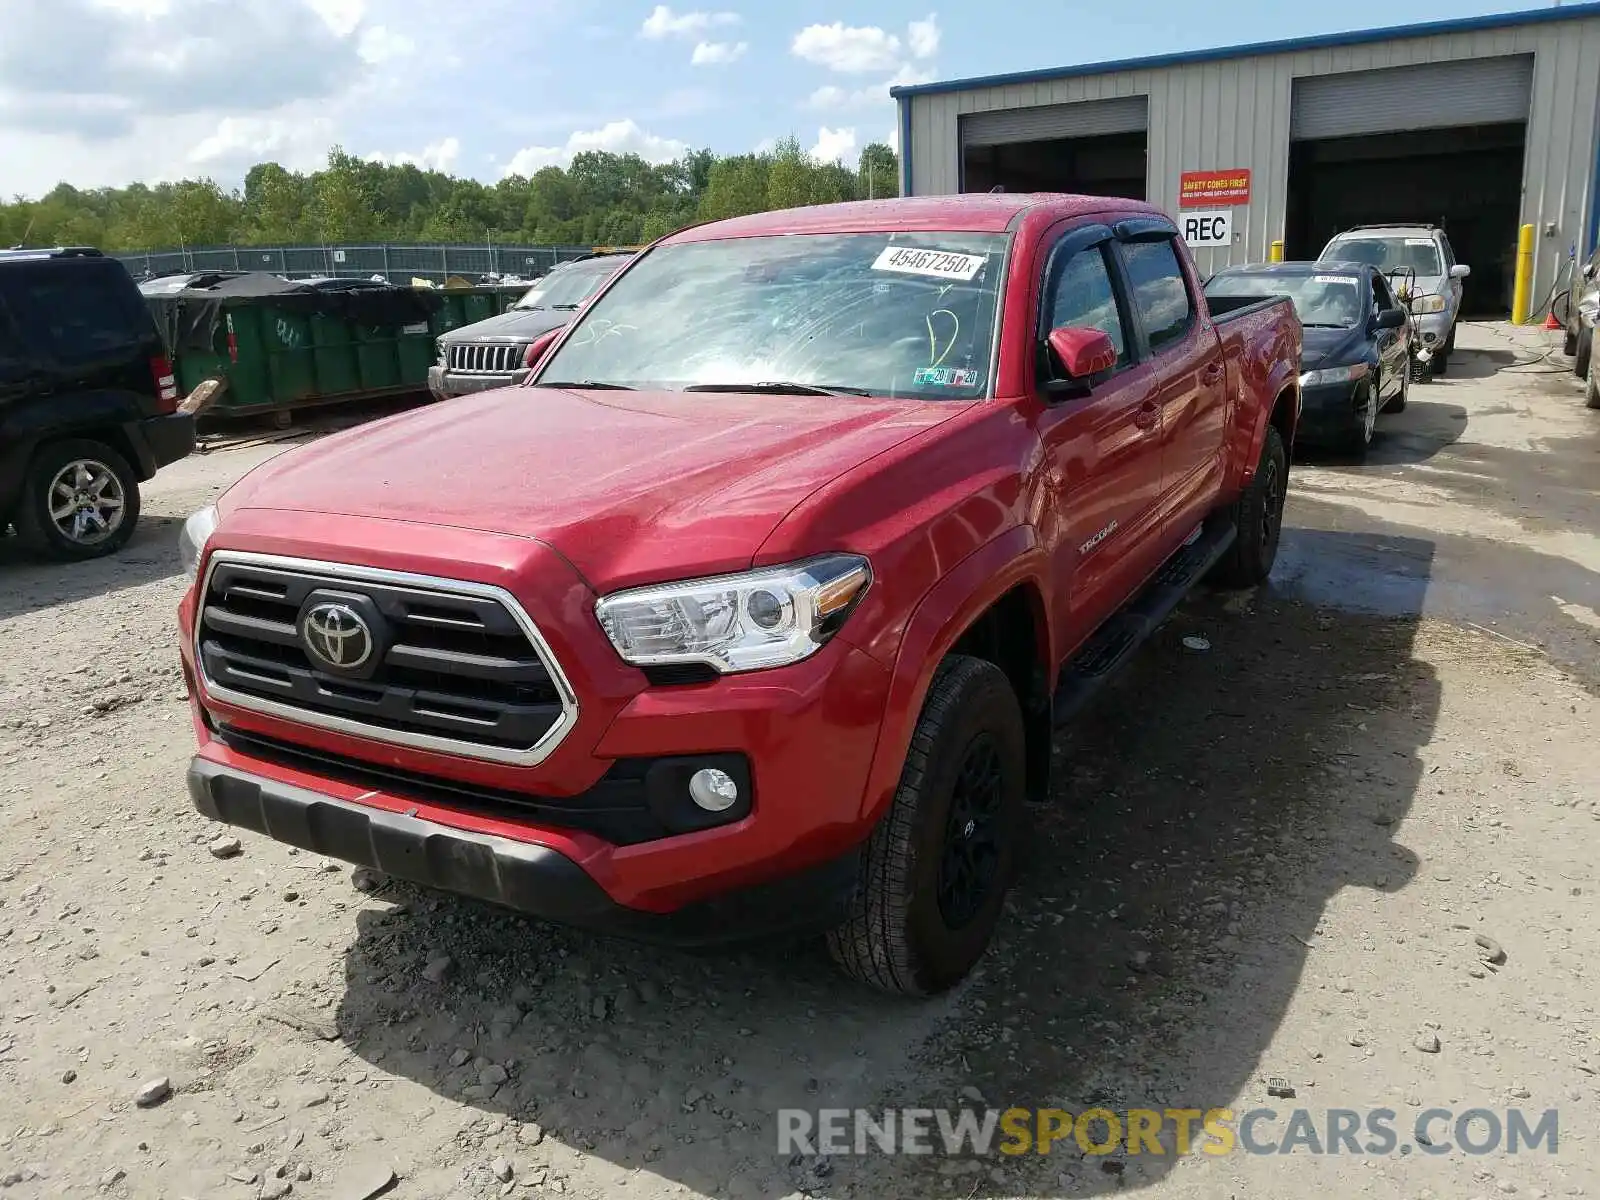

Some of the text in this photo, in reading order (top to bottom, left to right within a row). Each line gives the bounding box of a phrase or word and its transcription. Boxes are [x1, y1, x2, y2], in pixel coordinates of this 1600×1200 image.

[1183, 178, 1247, 190] SAFETY COMES FIRST
[1185, 216, 1226, 241] REC
[934, 369, 945, 381] 20
[965, 370, 976, 383] 20
[1078, 519, 1118, 554] TACOMA
